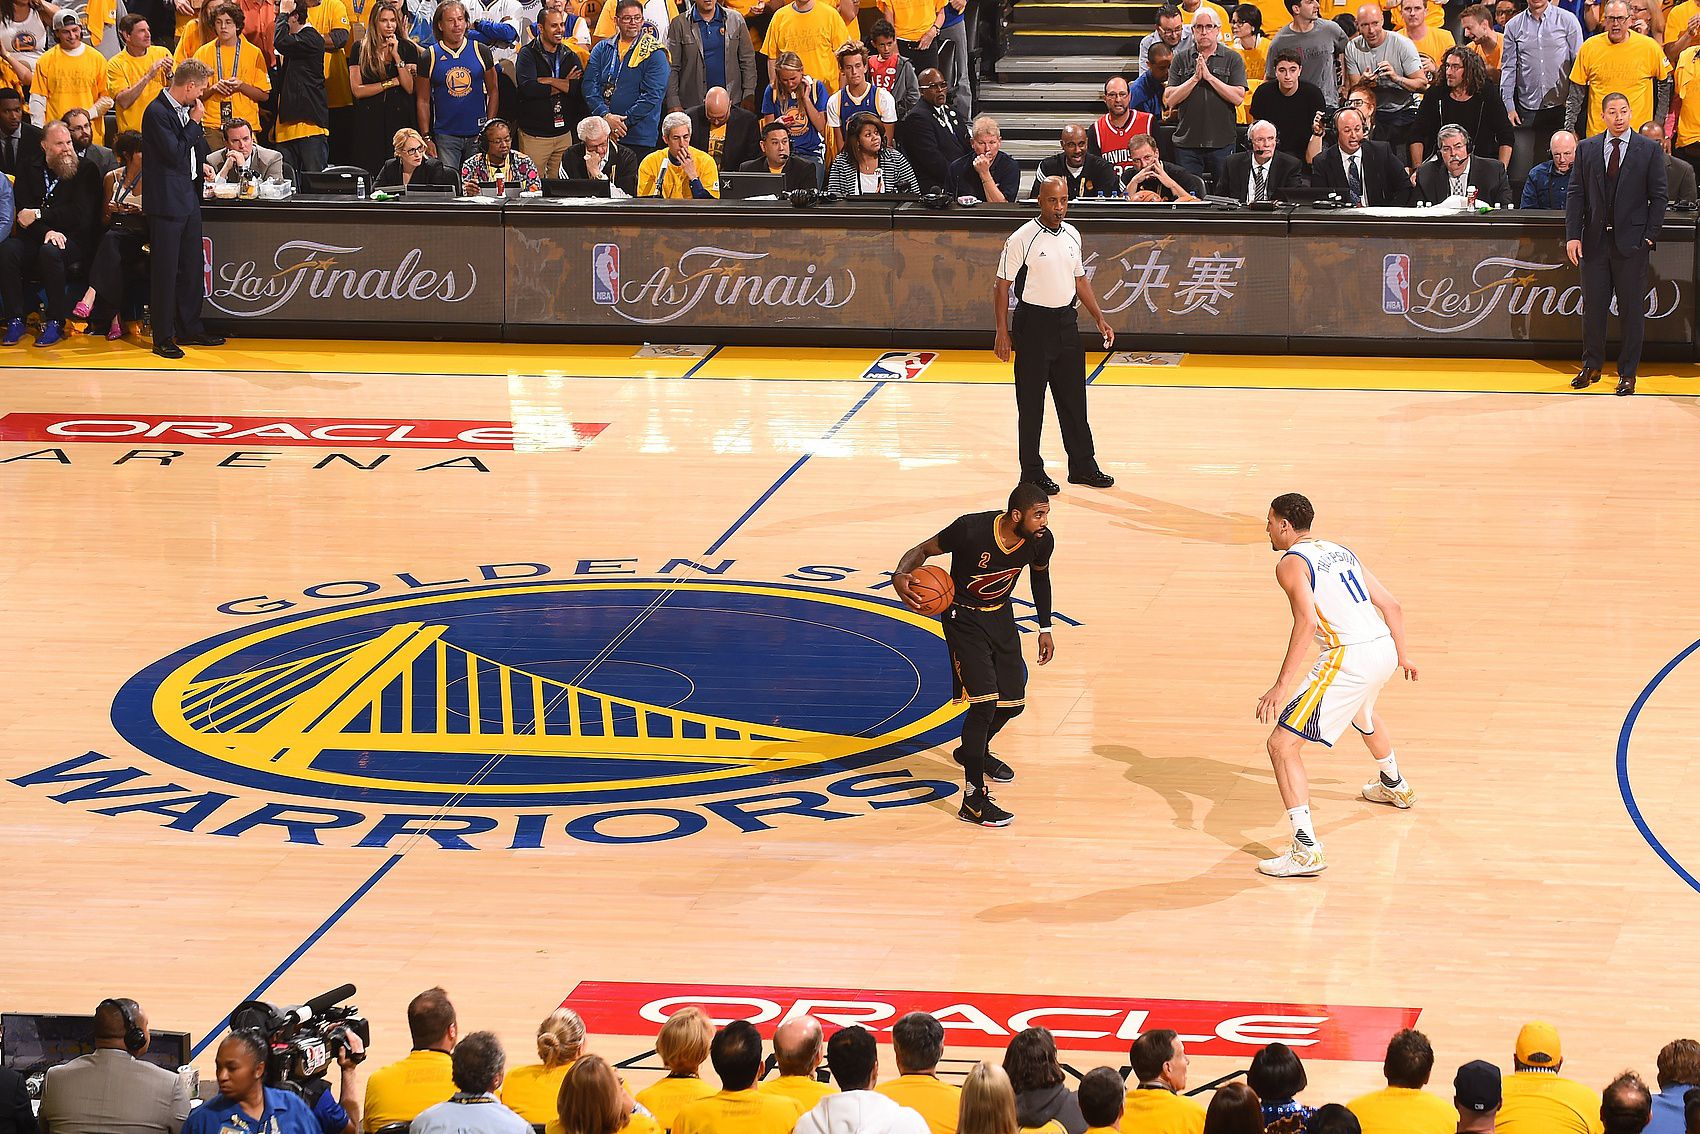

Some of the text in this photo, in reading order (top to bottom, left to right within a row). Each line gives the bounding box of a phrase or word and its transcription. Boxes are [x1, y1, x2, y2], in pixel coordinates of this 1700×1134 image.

[588, 3, 596, 12] 11
[207, 240, 477, 317] Las Finales
[596, 291, 612, 301] NBA
[610, 246, 857, 324] As Finais
[1078, 249, 1246, 316] 决赛
[1404, 256, 1681, 334] Les Finas
[46, 419, 526, 443] ORACLE
[0, 448, 491, 473] ARENA
[978, 551, 991, 569] 2
[216, 558, 737, 615] GOLDEN
[1339, 569, 1367, 604] 11
[5, 750, 960, 850] WARRIORS
[638, 995, 1330, 1047] ORACLE
